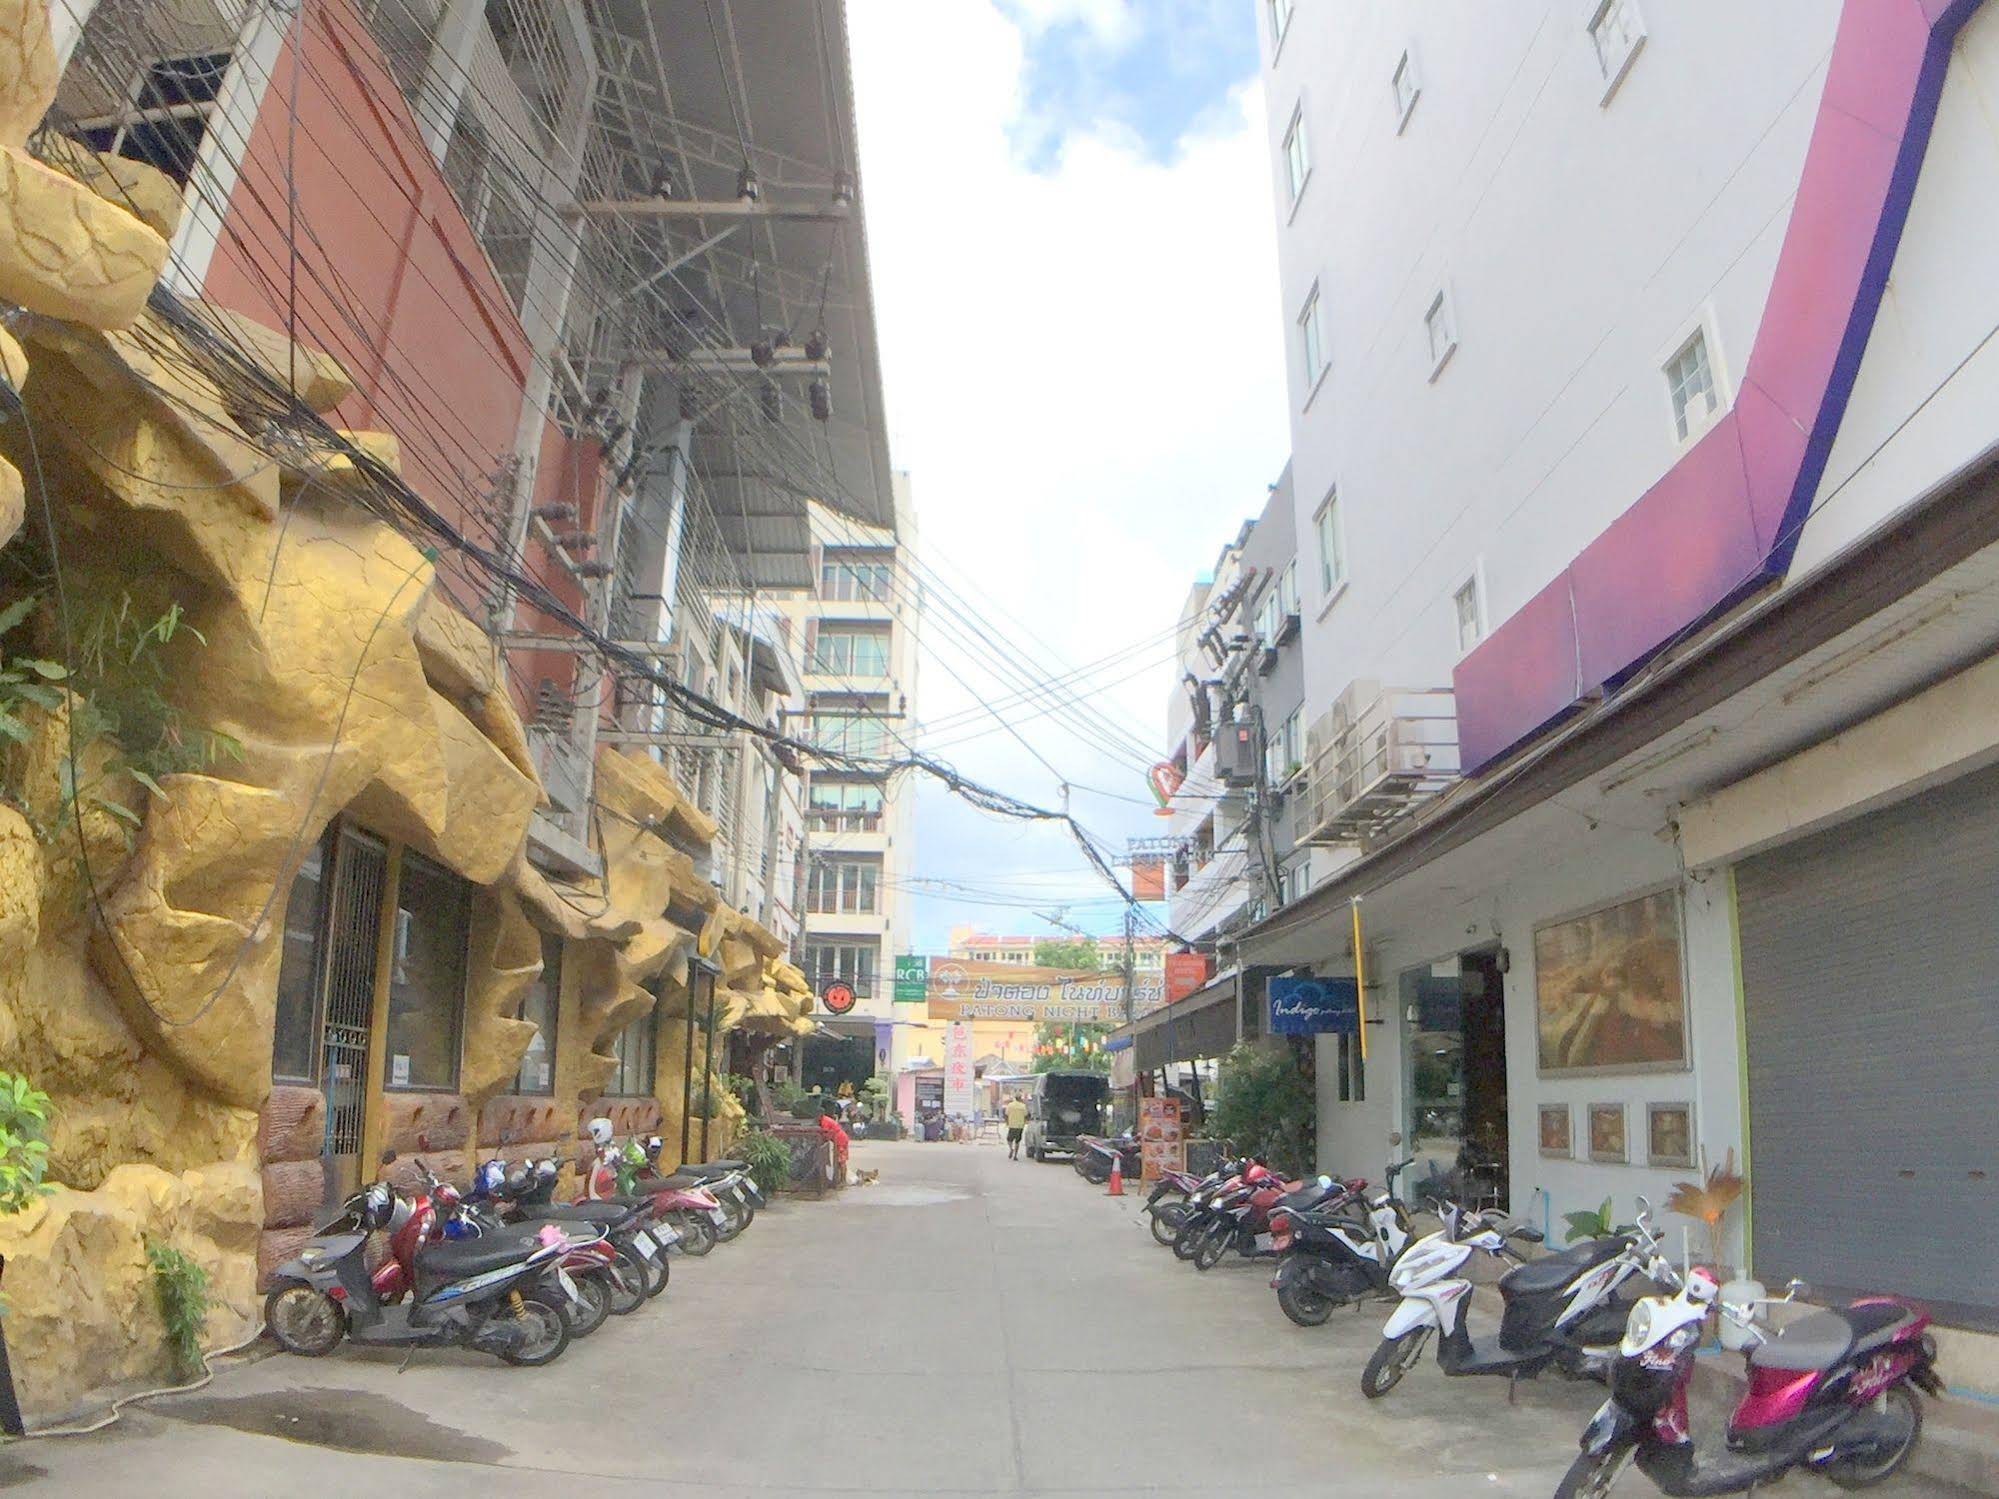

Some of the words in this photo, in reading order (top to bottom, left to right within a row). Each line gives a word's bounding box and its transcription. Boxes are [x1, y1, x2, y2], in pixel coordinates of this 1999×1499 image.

[896, 968, 925, 982] RCB
[961, 1004, 1034, 1017] PATONG
[1044, 1005, 1098, 1017] NIGHT
[1272, 998, 1321, 1021] Indigo
